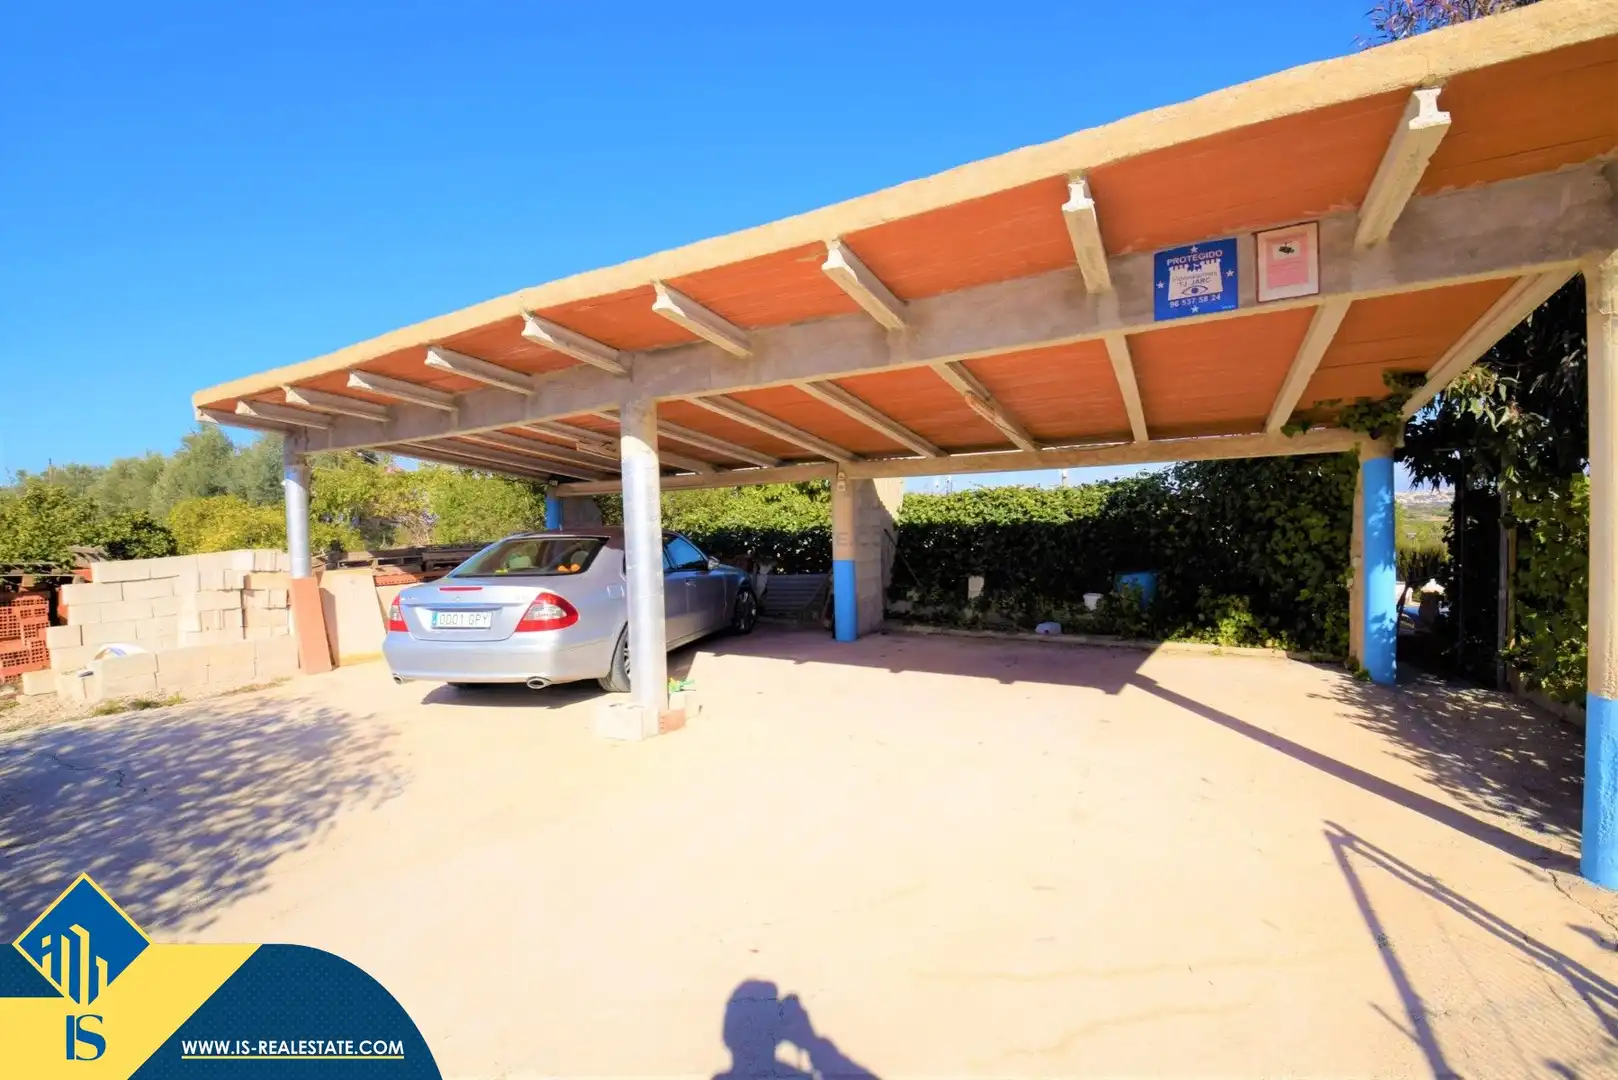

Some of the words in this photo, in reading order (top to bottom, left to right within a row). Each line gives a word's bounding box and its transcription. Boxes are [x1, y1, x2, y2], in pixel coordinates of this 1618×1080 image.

[1167, 249, 1223, 266] PROTEGIDO
[1169, 300, 1180, 308] 96
[1181, 297, 1195, 306] 537
[1198, 295, 1209, 304] 58
[1211, 293, 1221, 302] 24
[440, 612, 464, 625] 0001
[468, 612, 488, 625] GPY
